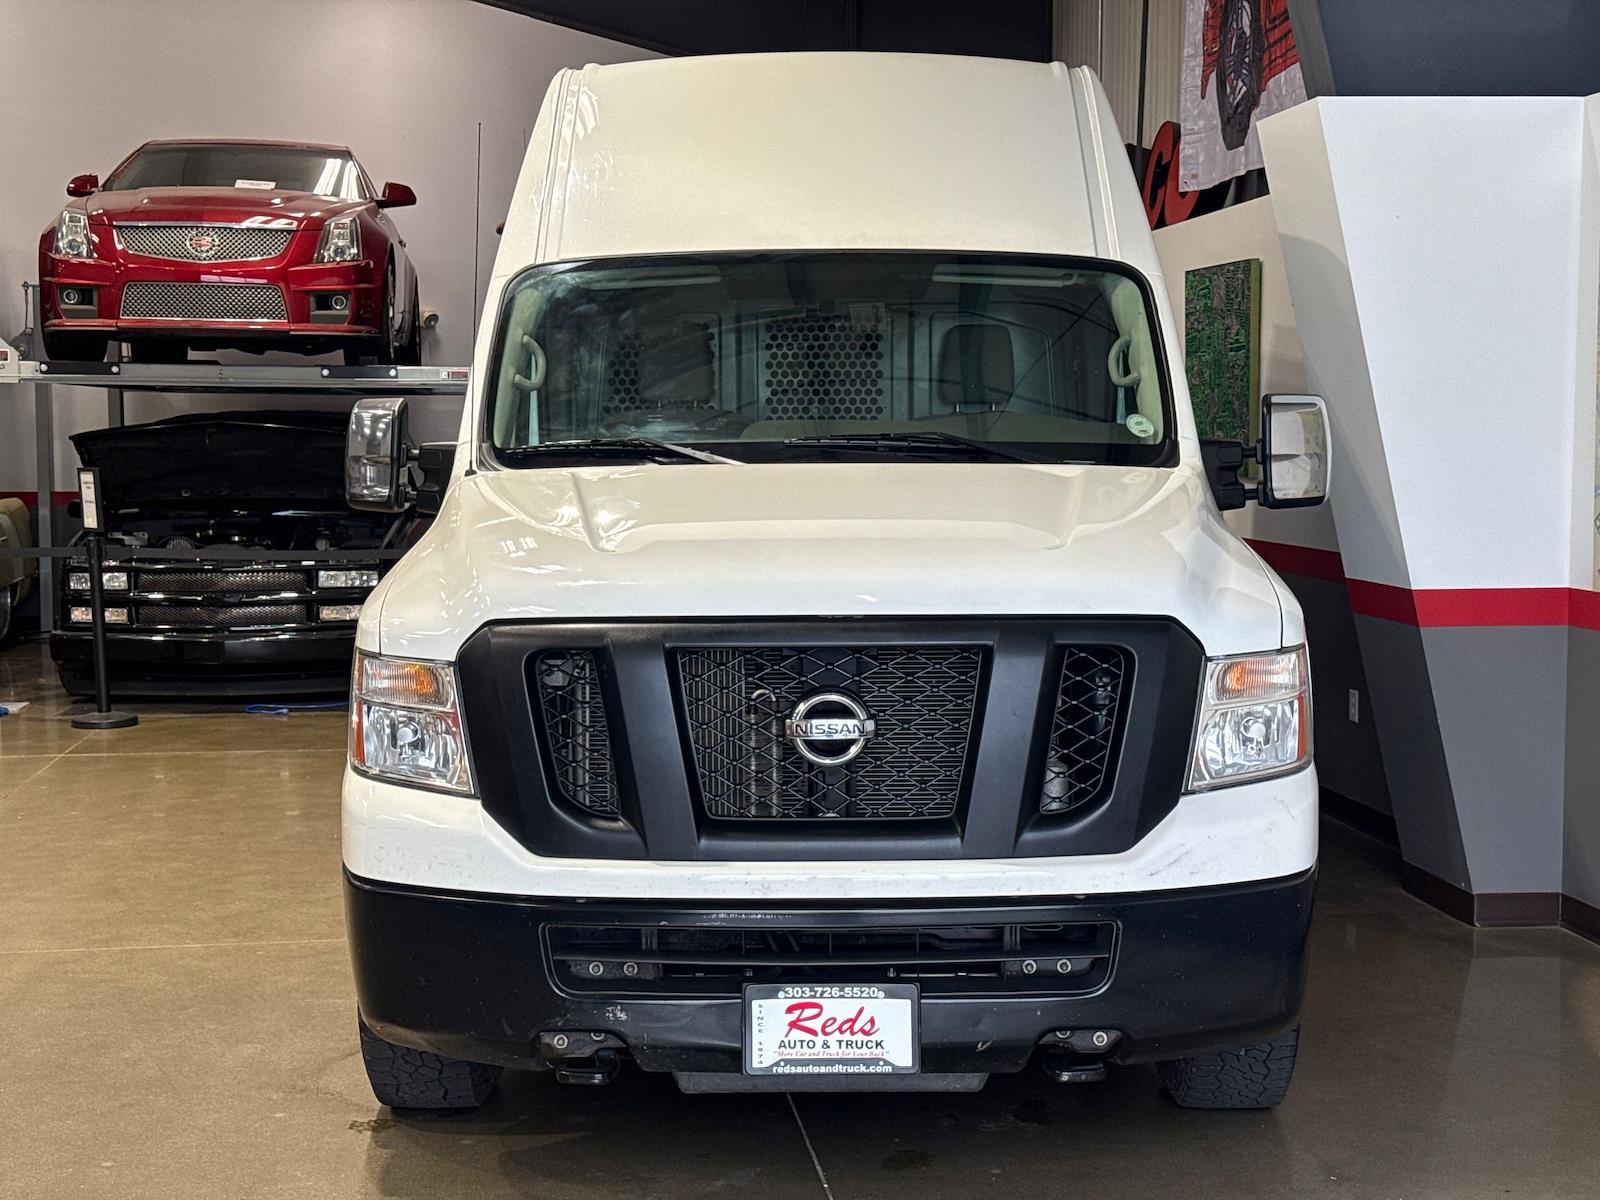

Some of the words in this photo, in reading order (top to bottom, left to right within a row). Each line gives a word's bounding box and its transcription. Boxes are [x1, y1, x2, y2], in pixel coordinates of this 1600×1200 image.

[794, 722, 866, 736] NISSAN
[784, 987, 879, 998] 303-726-5520
[785, 1002, 880, 1038] Reds
[778, 1040, 816, 1050] AUTO
[821, 1040, 831, 1050] &
[836, 1040, 885, 1050] TRUCK
[772, 1064, 893, 1073] redsautoandtruck.com
